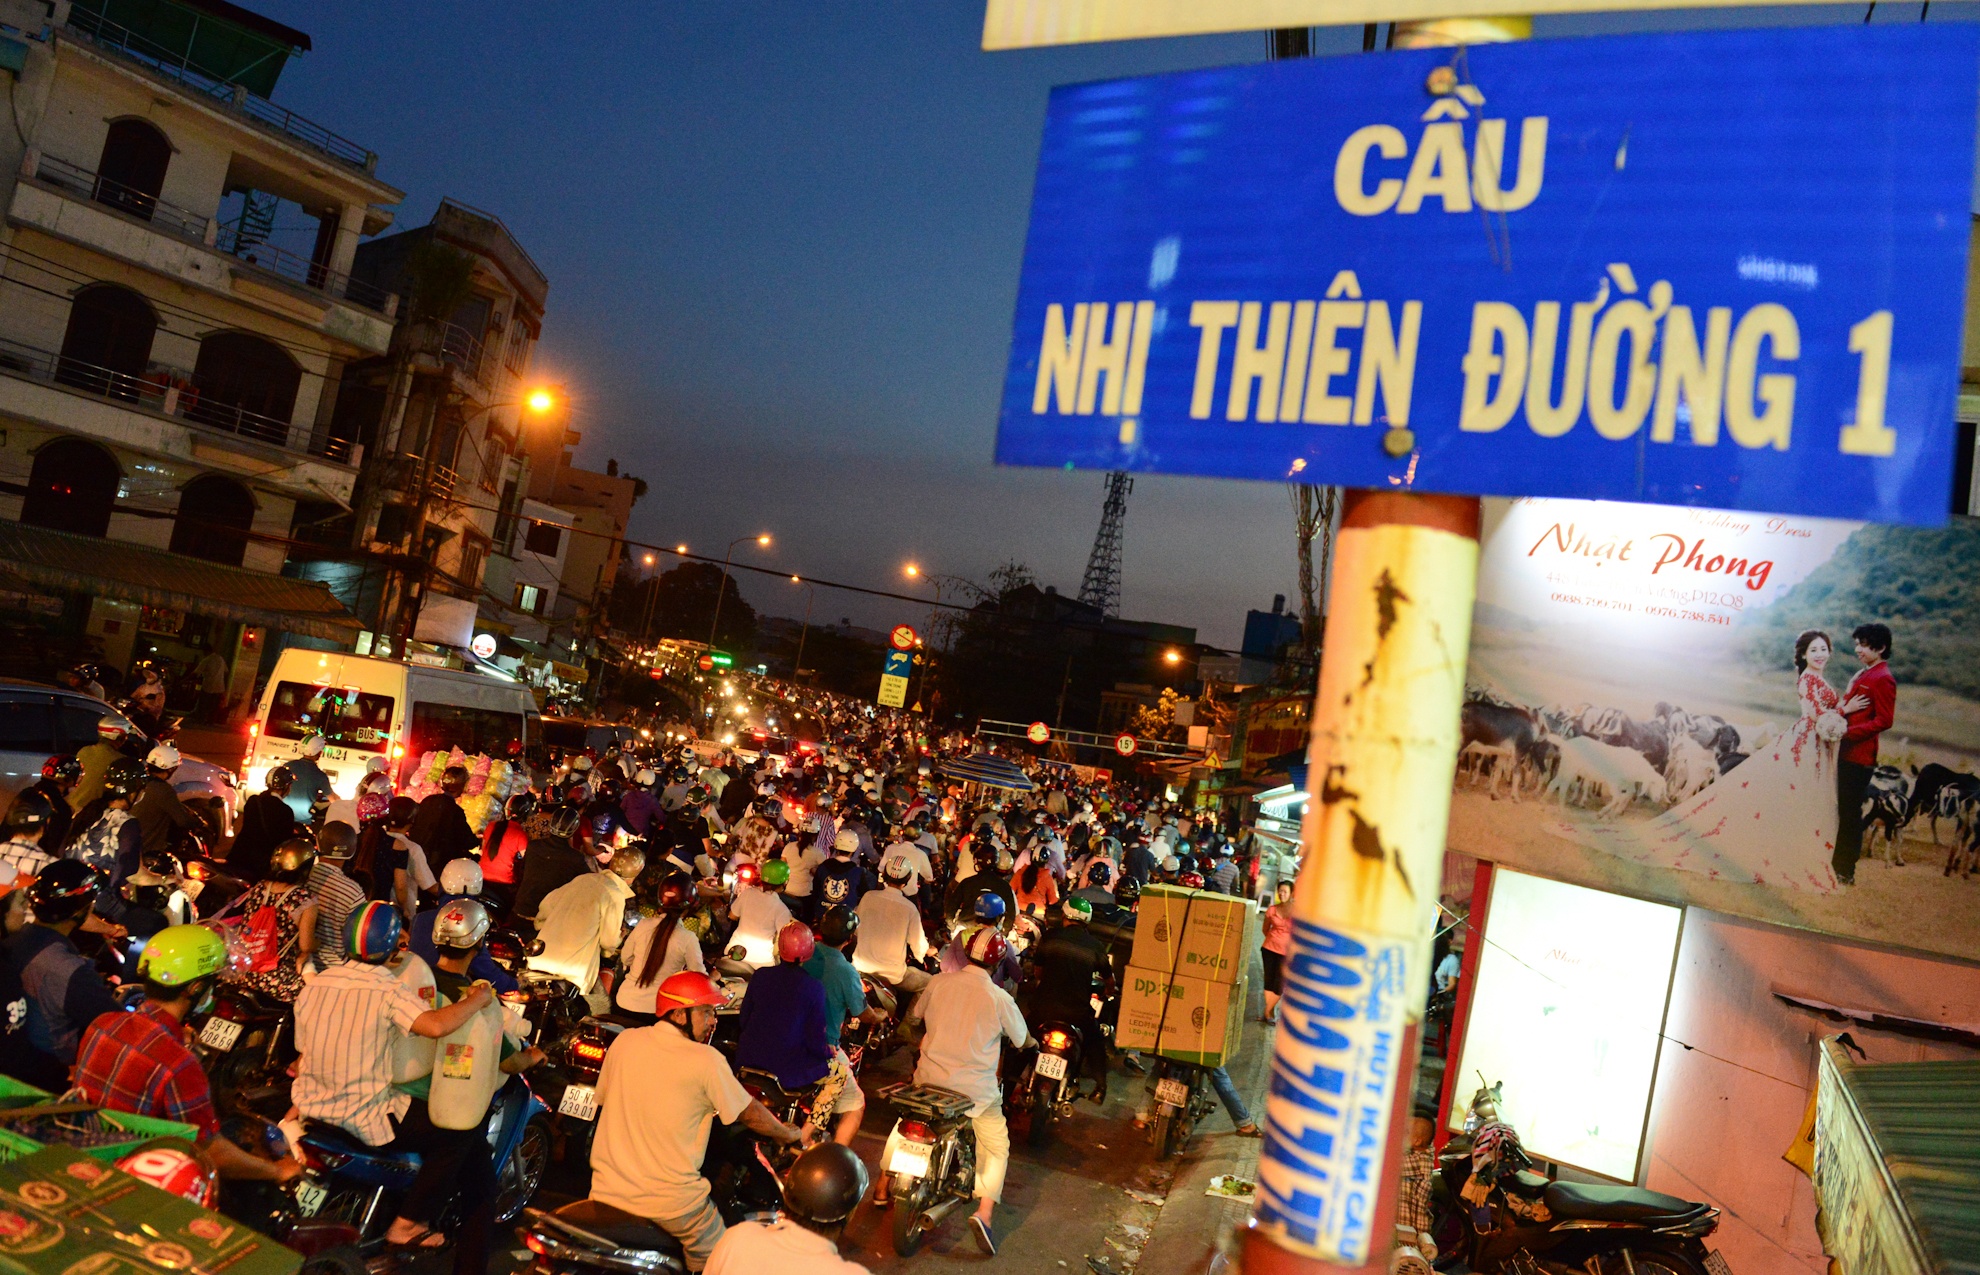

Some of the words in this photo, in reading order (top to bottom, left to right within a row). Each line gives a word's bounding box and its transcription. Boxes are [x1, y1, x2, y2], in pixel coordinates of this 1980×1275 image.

[1334, 85, 1548, 217] CẦU
[1032, 300, 1154, 444] NHỊ
[1189, 270, 1423, 428] THIÊN
[1459, 263, 1801, 452] ĐƯỜNG
[1838, 310, 1897, 457] 1
[1528, 522, 1634, 567] Nhật
[1650, 532, 1774, 591] Phong
[359, 729, 375, 740] BUS
[6, 997, 27, 1024] 39
